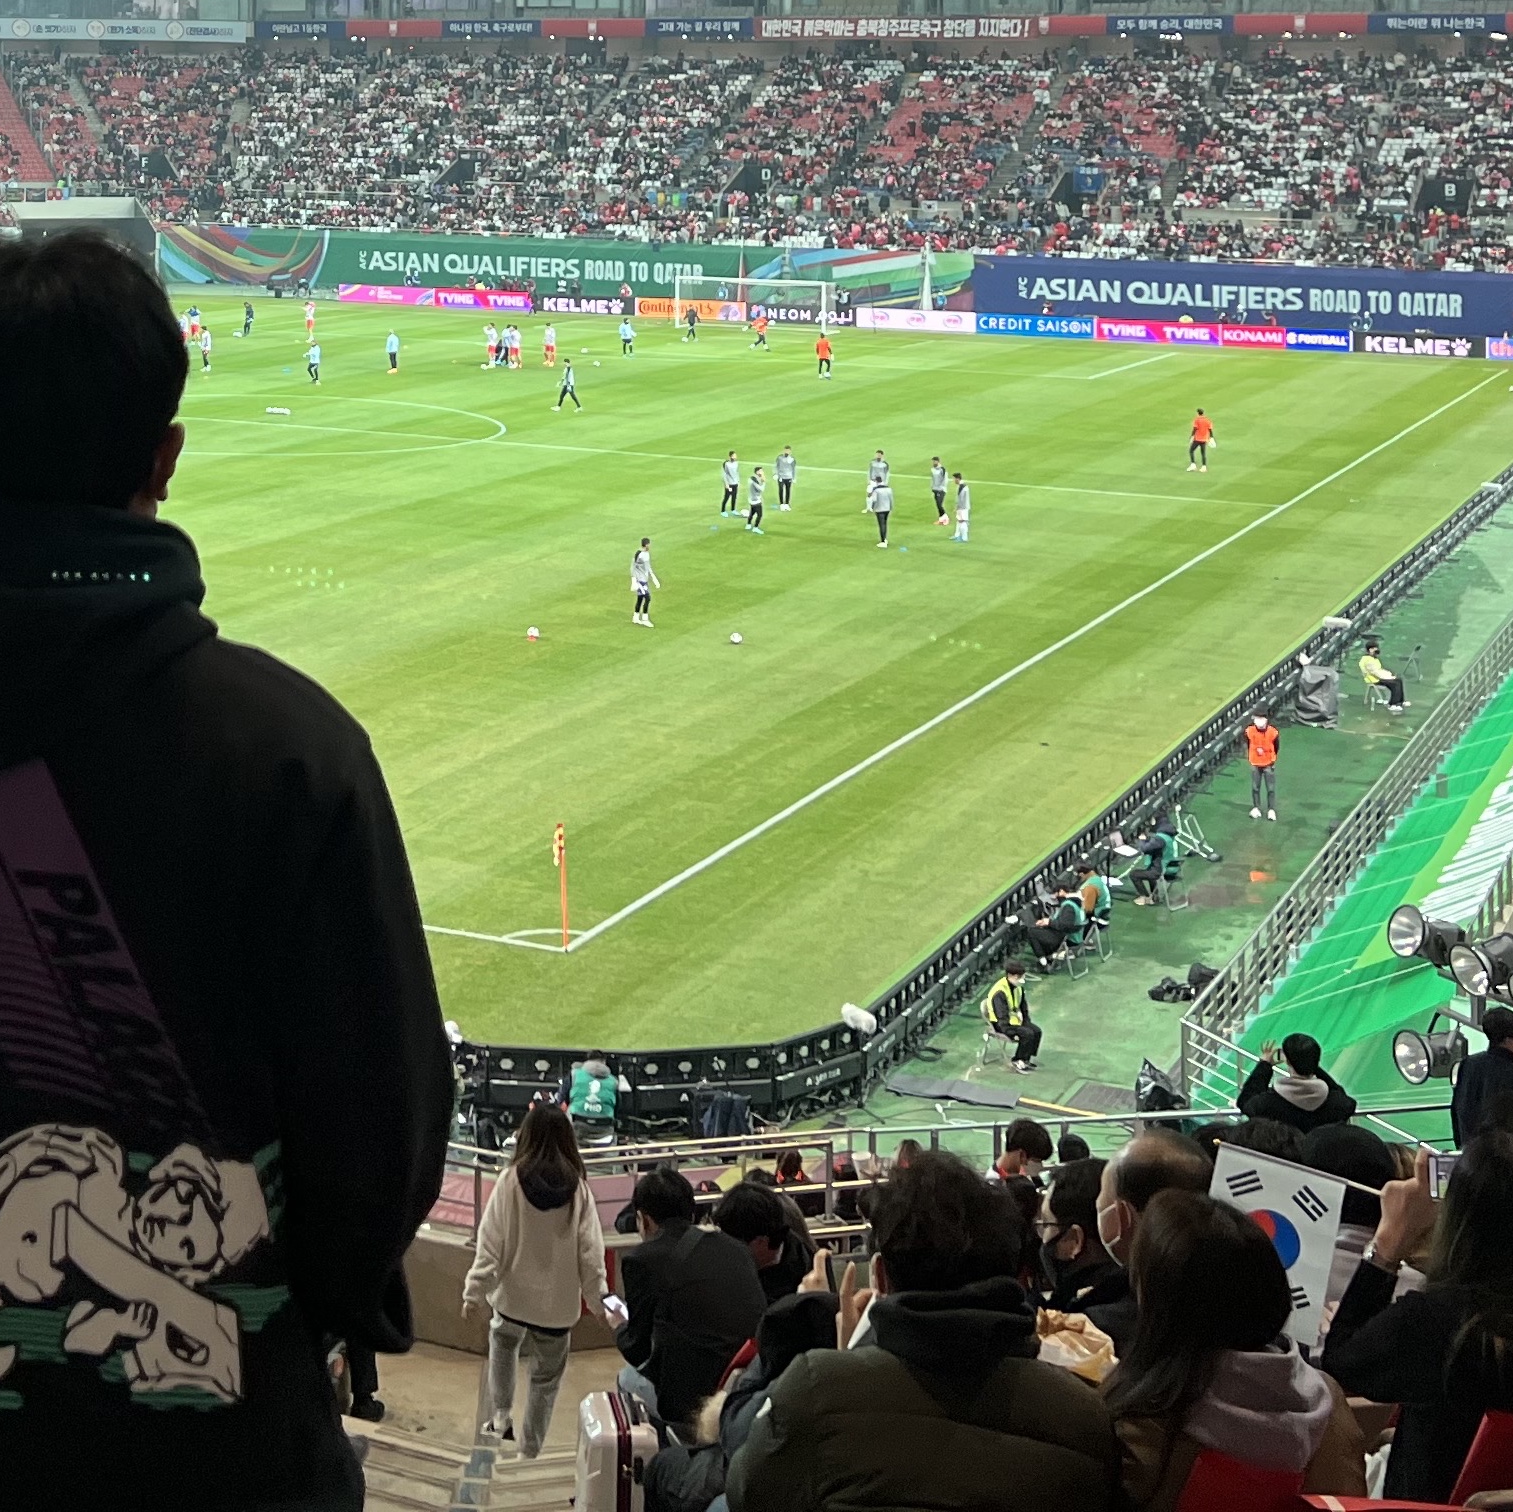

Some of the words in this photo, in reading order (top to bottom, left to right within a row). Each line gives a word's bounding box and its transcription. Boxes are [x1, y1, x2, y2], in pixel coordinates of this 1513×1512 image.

[657, 21, 675, 32] 그대
[676, 21, 692, 32] 가는
[705, 21, 721, 32] 우리
[723, 21, 740, 32] 함께
[761, 19, 803, 37] 대한민국
[803, 19, 855, 37] 붉은악마는
[856, 18, 942, 37] 충북청주프로축구
[943, 18, 976, 38] 창단을
[1116, 19, 1136, 30] 모두
[1138, 19, 1158, 30] 함께
[1183, 18, 1223, 30] 대한민국
[141, 156, 149, 168] F
[761, 168, 771, 180] D
[1444, 182, 1456, 197] B
[359, 250, 368, 270] AFC
[368, 251, 440, 274] ASIAN
[443, 254, 580, 280] QUALIFIERS
[584, 259, 624, 282] ROAD
[629, 261, 649, 283] TO
[653, 263, 703, 285] QATAR
[438, 292, 475, 305] TVING
[488, 294, 525, 307] TVING
[1017, 276, 1028, 300] AFC
[1029, 277, 1122, 303] ASIAN
[1127, 281, 1304, 311] QUALIFIERS
[1309, 288, 1362, 313] ROAD
[1367, 289, 1392, 315] TO
[1398, 291, 1463, 318] QATAR
[543, 296, 609, 314] KELME
[767, 307, 811, 321] NEOM
[978, 315, 1033, 331] CREDIT
[1036, 319, 1092, 335] SAISON
[1101, 323, 1147, 338] TVING
[1162, 326, 1210, 341] TVING
[1223, 329, 1283, 344] KONAMI
[1365, 335, 1451, 356] KELME
